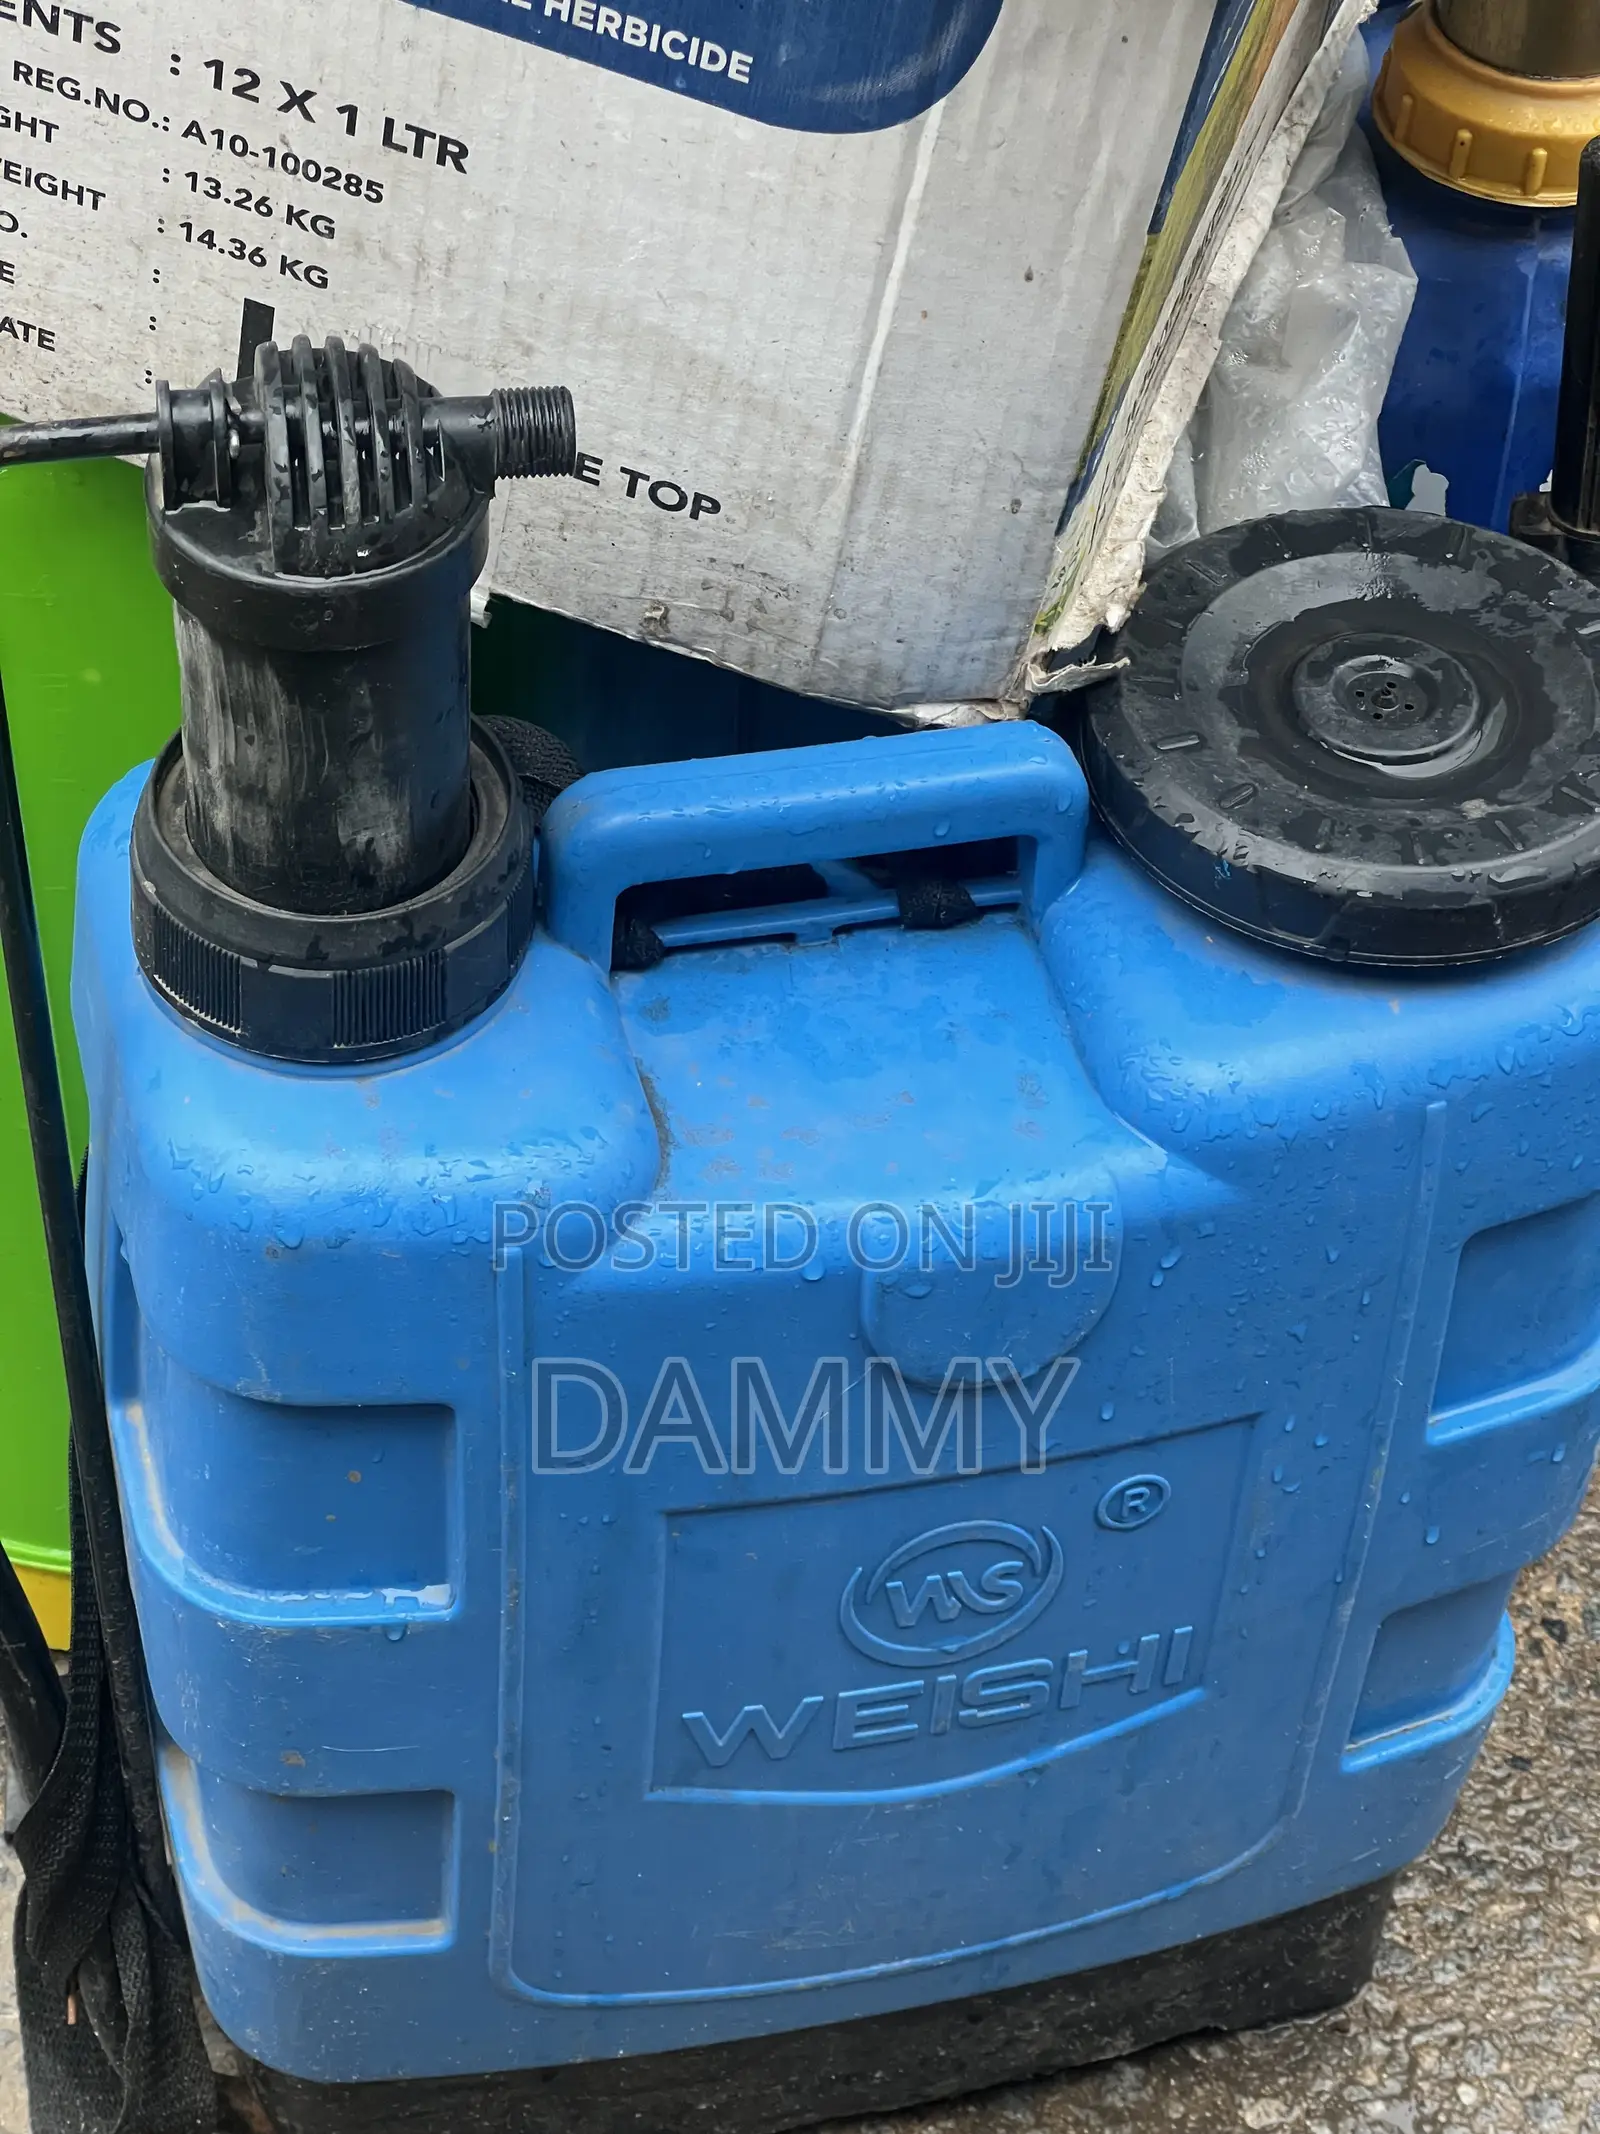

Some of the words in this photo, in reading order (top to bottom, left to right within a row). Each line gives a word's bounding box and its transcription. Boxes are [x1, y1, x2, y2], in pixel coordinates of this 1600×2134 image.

[544, 0, 754, 84] HERBICIDE
[203, 58, 261, 104] 12
[276, 80, 318, 124] X
[335, 104, 359, 137] 1
[381, 116, 469, 175] LTR
[180, 119, 384, 204] A10-100285
[0, 157, 106, 211] EIGHT
[178, 221, 267, 268] 14.36
[279, 254, 329, 290] KG
[184, 171, 274, 218] 13.26
[285, 203, 336, 240] KG
[0, 316, 56, 352] ATE
[619, 466, 722, 521] TOP
[681, 1625, 1194, 1768] WEISHI
